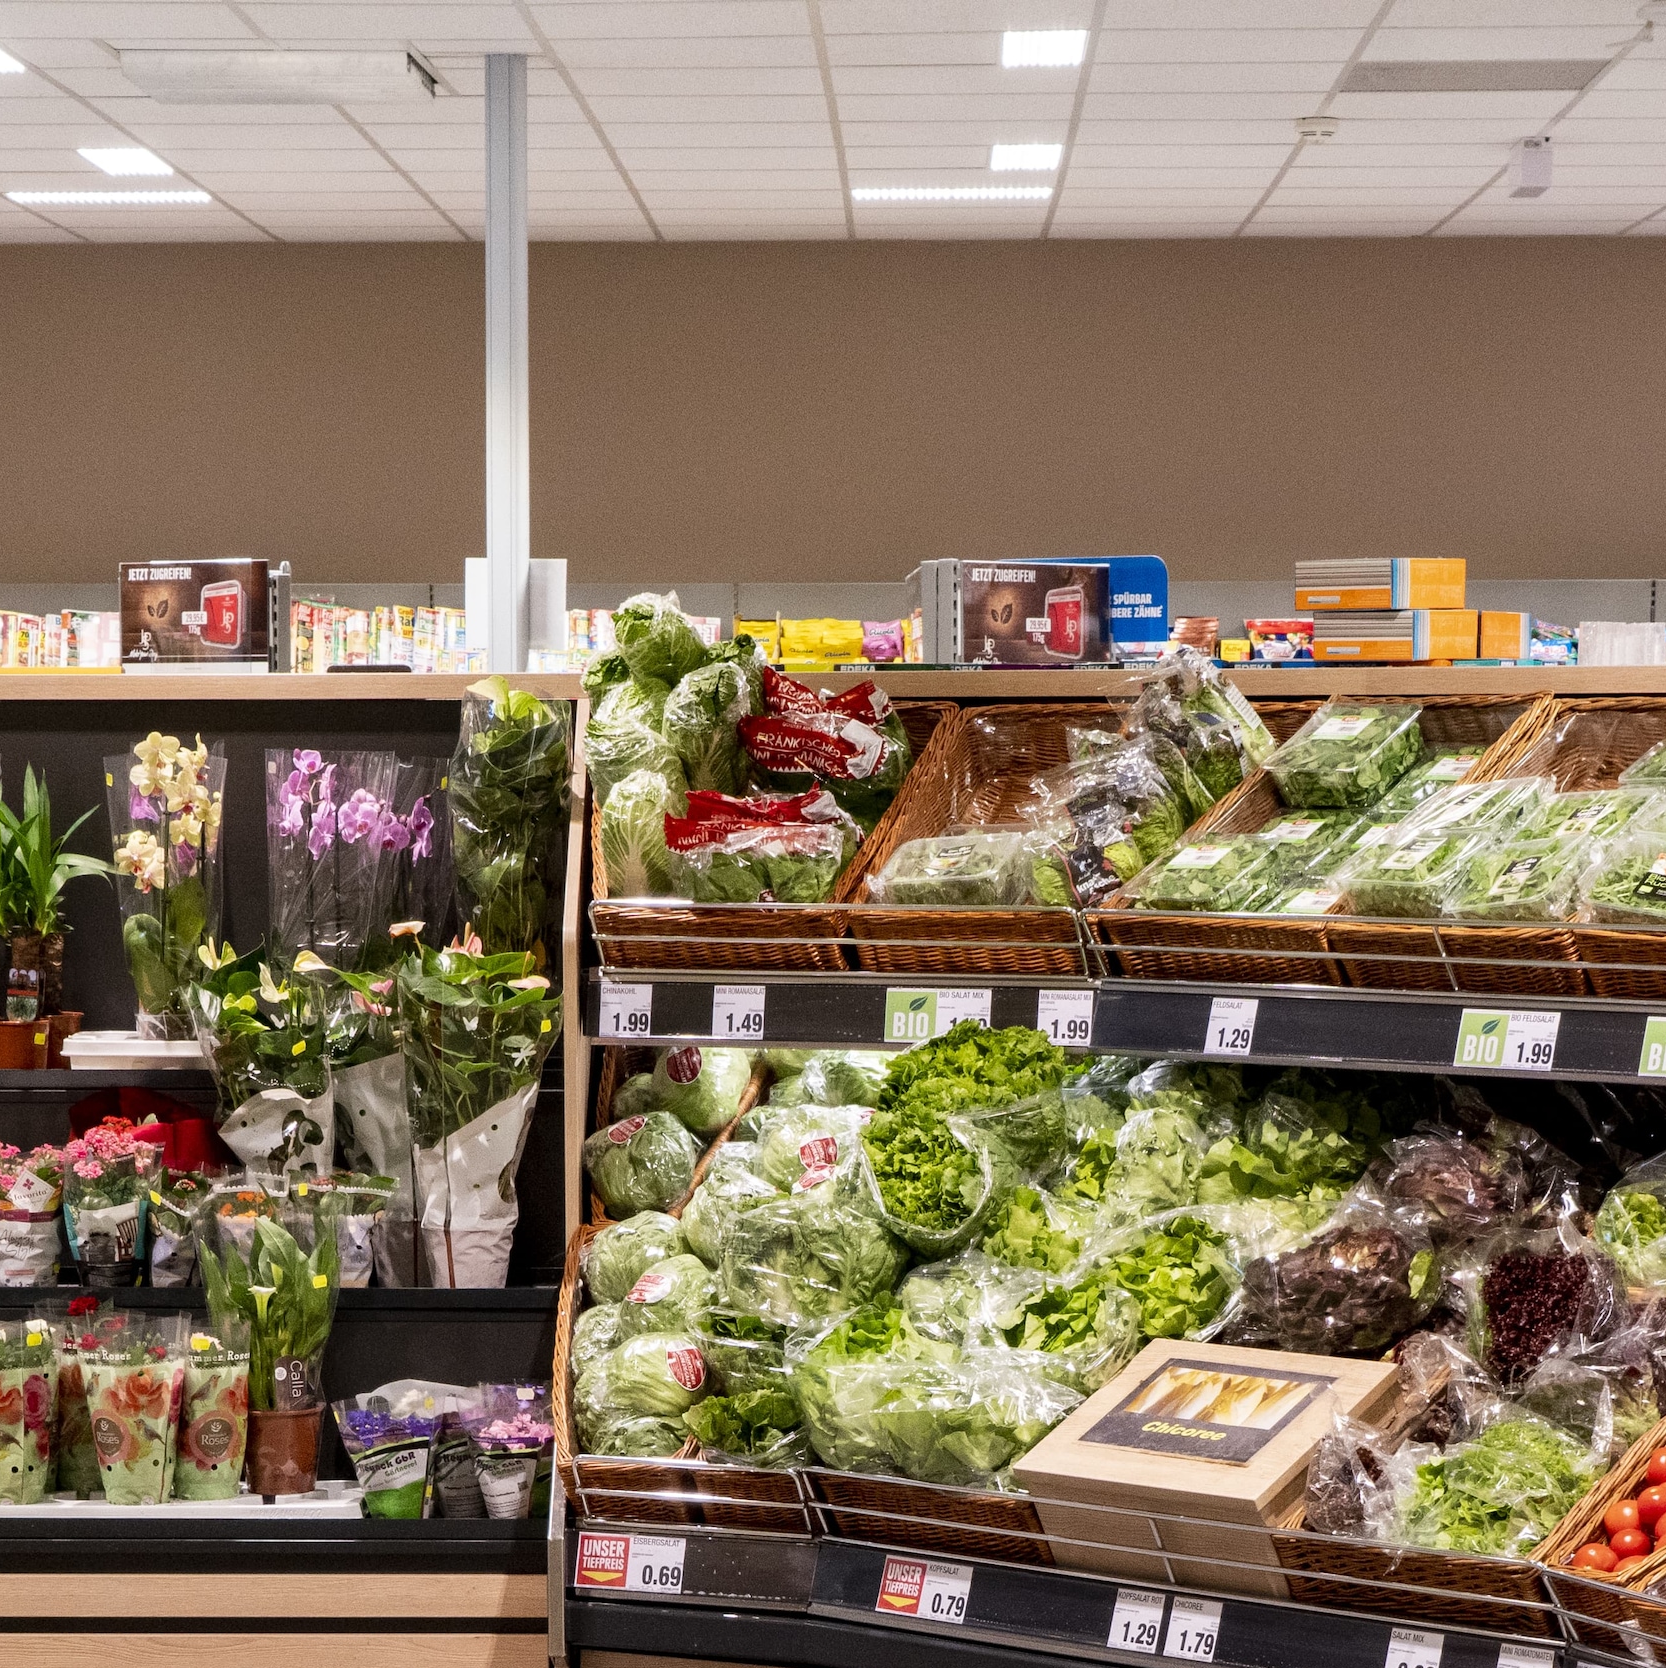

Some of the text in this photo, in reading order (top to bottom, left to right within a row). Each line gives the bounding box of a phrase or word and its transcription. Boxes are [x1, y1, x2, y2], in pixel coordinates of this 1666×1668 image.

[128, 565, 192, 581] JETZT ZUGREIFEN!
[972, 568, 1036, 583] JETZT ZUGREIFEN!
[1113, 592, 1152, 606] SPÜRBAR
[602, 986, 637, 996] CHINAKOHL
[1212, 1000, 1245, 1010] FELDSALAT
[614, 1013, 648, 1032] 1.99
[727, 1013, 762, 1032] 1.49
[893, 1014, 927, 1038] BIO
[1052, 1020, 1088, 1039] 1.99
[1219, 1028, 1250, 1048] 1.29
[1463, 1035, 1498, 1063] BIO
[1518, 1043, 1552, 1064] 1.99
[289, 1359, 305, 1398] Calla
[96, 1433, 120, 1447] Roses
[200, 1432, 230, 1447] Roses
[1141, 1419, 1227, 1442] Chicoree
[583, 1538, 625, 1558] UNSER
[633, 1537, 681, 1548] EISBERGSALAT
[582, 1556, 625, 1571] TIEFPREIS
[886, 1562, 922, 1584] UNSER
[929, 1563, 960, 1576] KOPFSALAT
[642, 1565, 681, 1586] 0.69
[884, 1579, 920, 1598] TIEFPREIS
[932, 1593, 964, 1617] 0.79
[1175, 1599, 1204, 1612] CHICOREE
[1124, 1622, 1156, 1645] 1.29
[1181, 1631, 1214, 1655] 1.79
[1392, 1630, 1425, 1643] SALAT MIX
